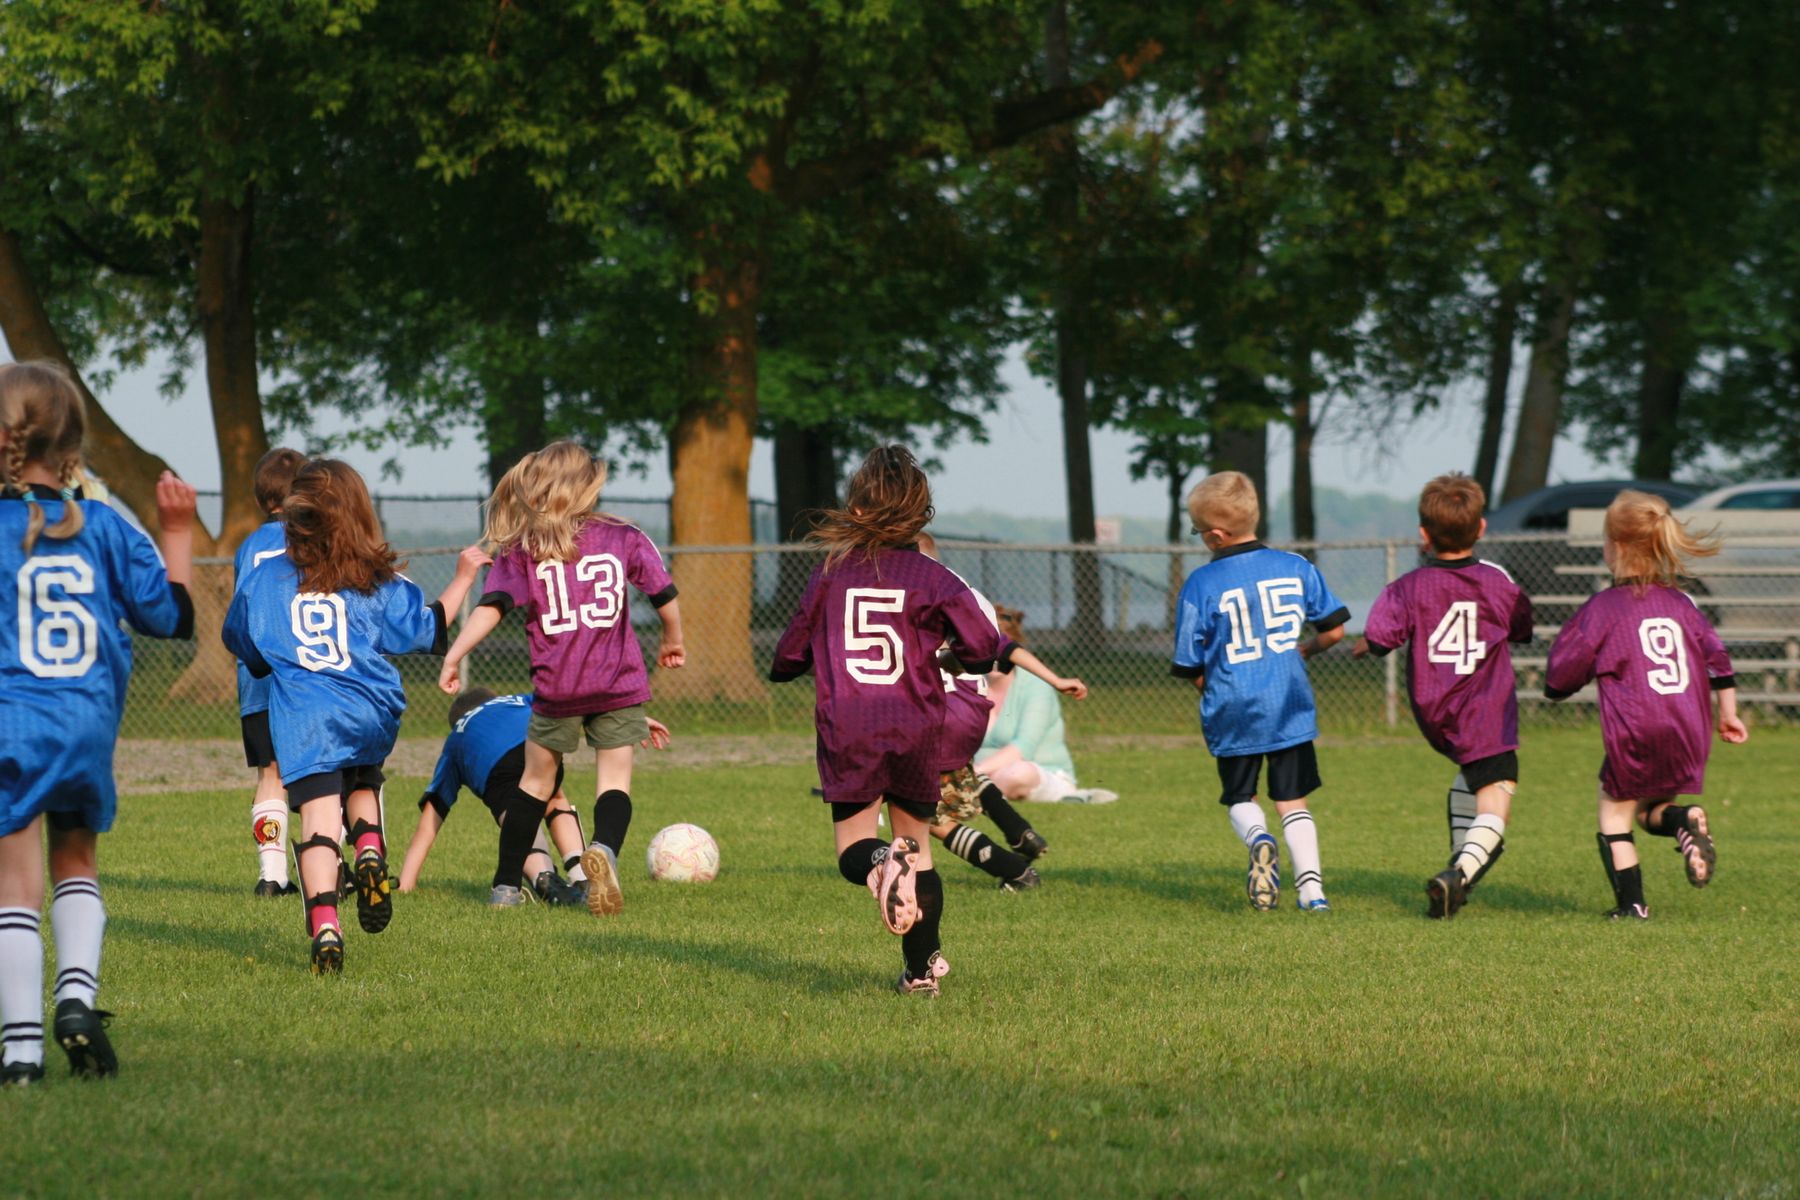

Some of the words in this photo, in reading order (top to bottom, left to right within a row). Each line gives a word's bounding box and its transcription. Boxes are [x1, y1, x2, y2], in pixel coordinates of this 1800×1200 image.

[17, 554, 98, 678] 6
[290, 592, 352, 672] 9
[536, 552, 625, 635] 13
[1219, 577, 1305, 665] 15
[845, 588, 905, 685] 5
[1428, 601, 1487, 675] 4
[1638, 617, 1690, 695] 9
